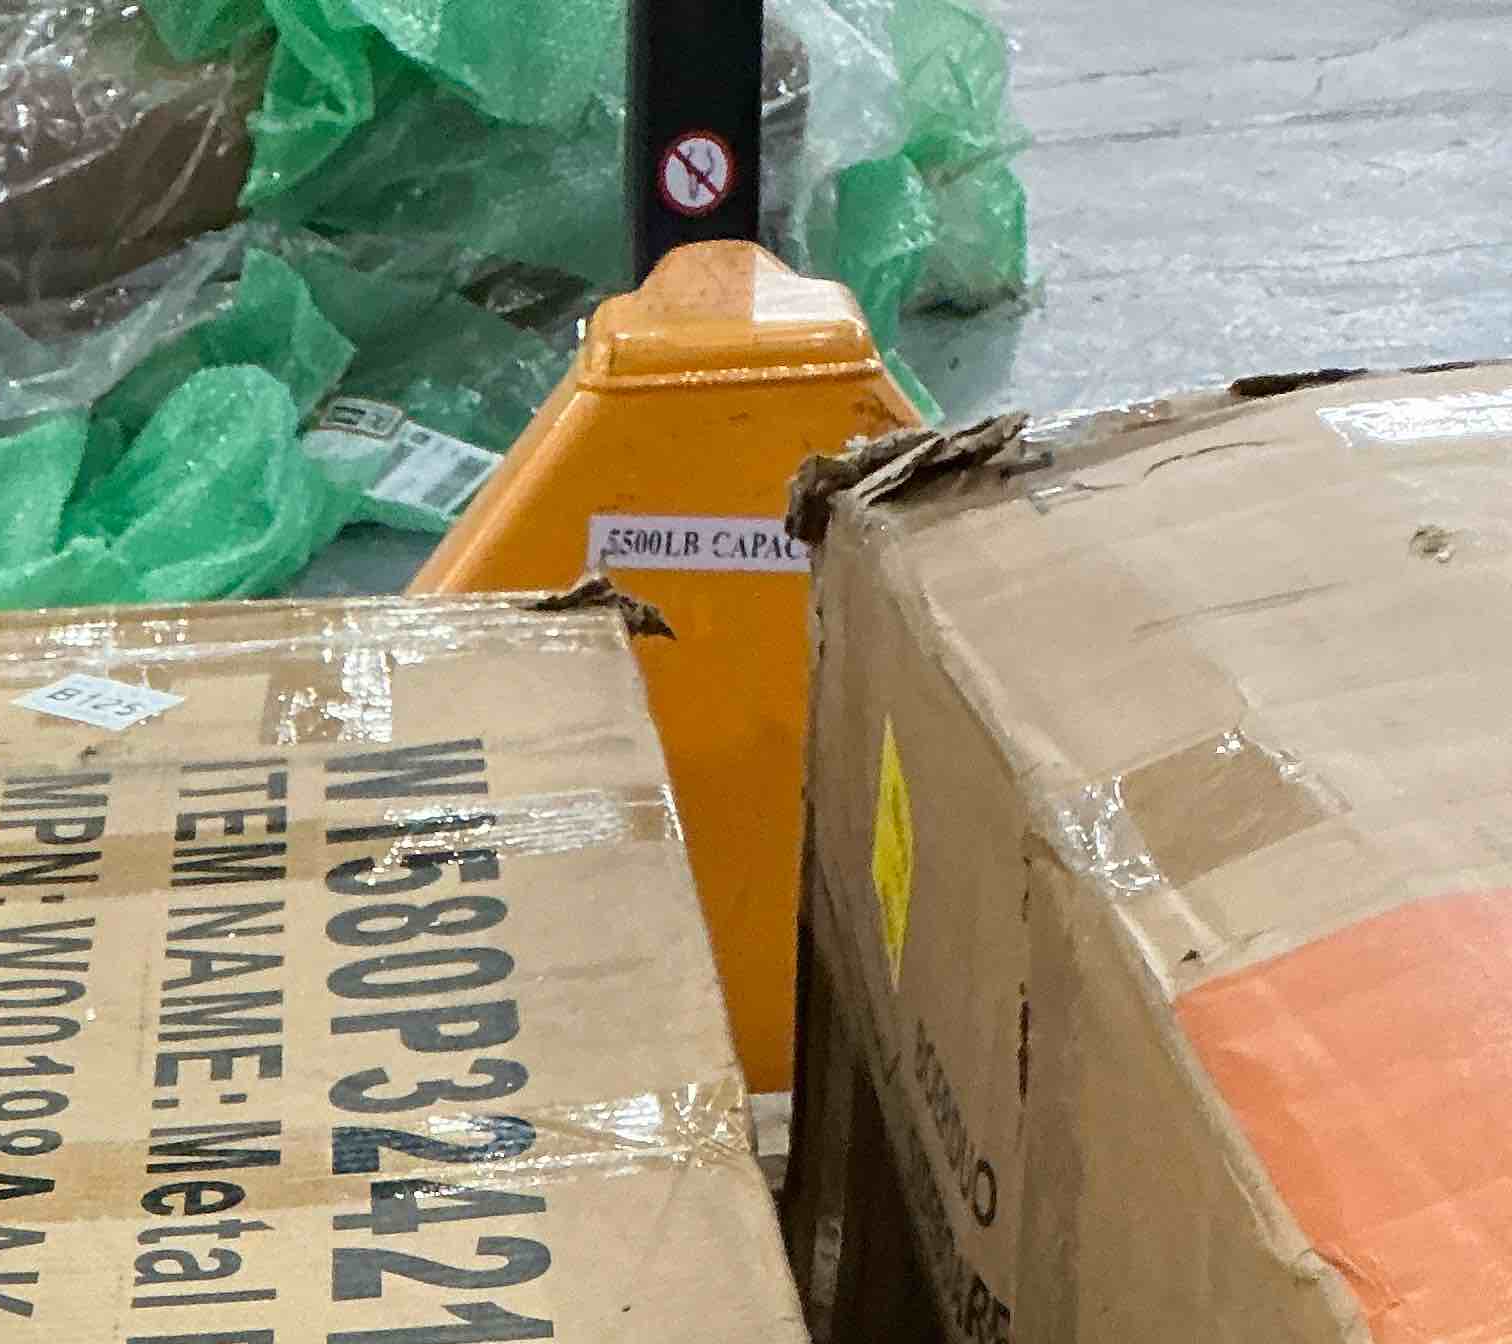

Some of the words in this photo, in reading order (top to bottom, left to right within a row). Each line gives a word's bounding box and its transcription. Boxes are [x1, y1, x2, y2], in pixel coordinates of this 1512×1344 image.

[606, 528, 699, 557] 5500LB
[171, 759, 290, 888] ITEM
[151, 901, 285, 1111] NAME:
[129, 1120, 282, 1310] Metal
